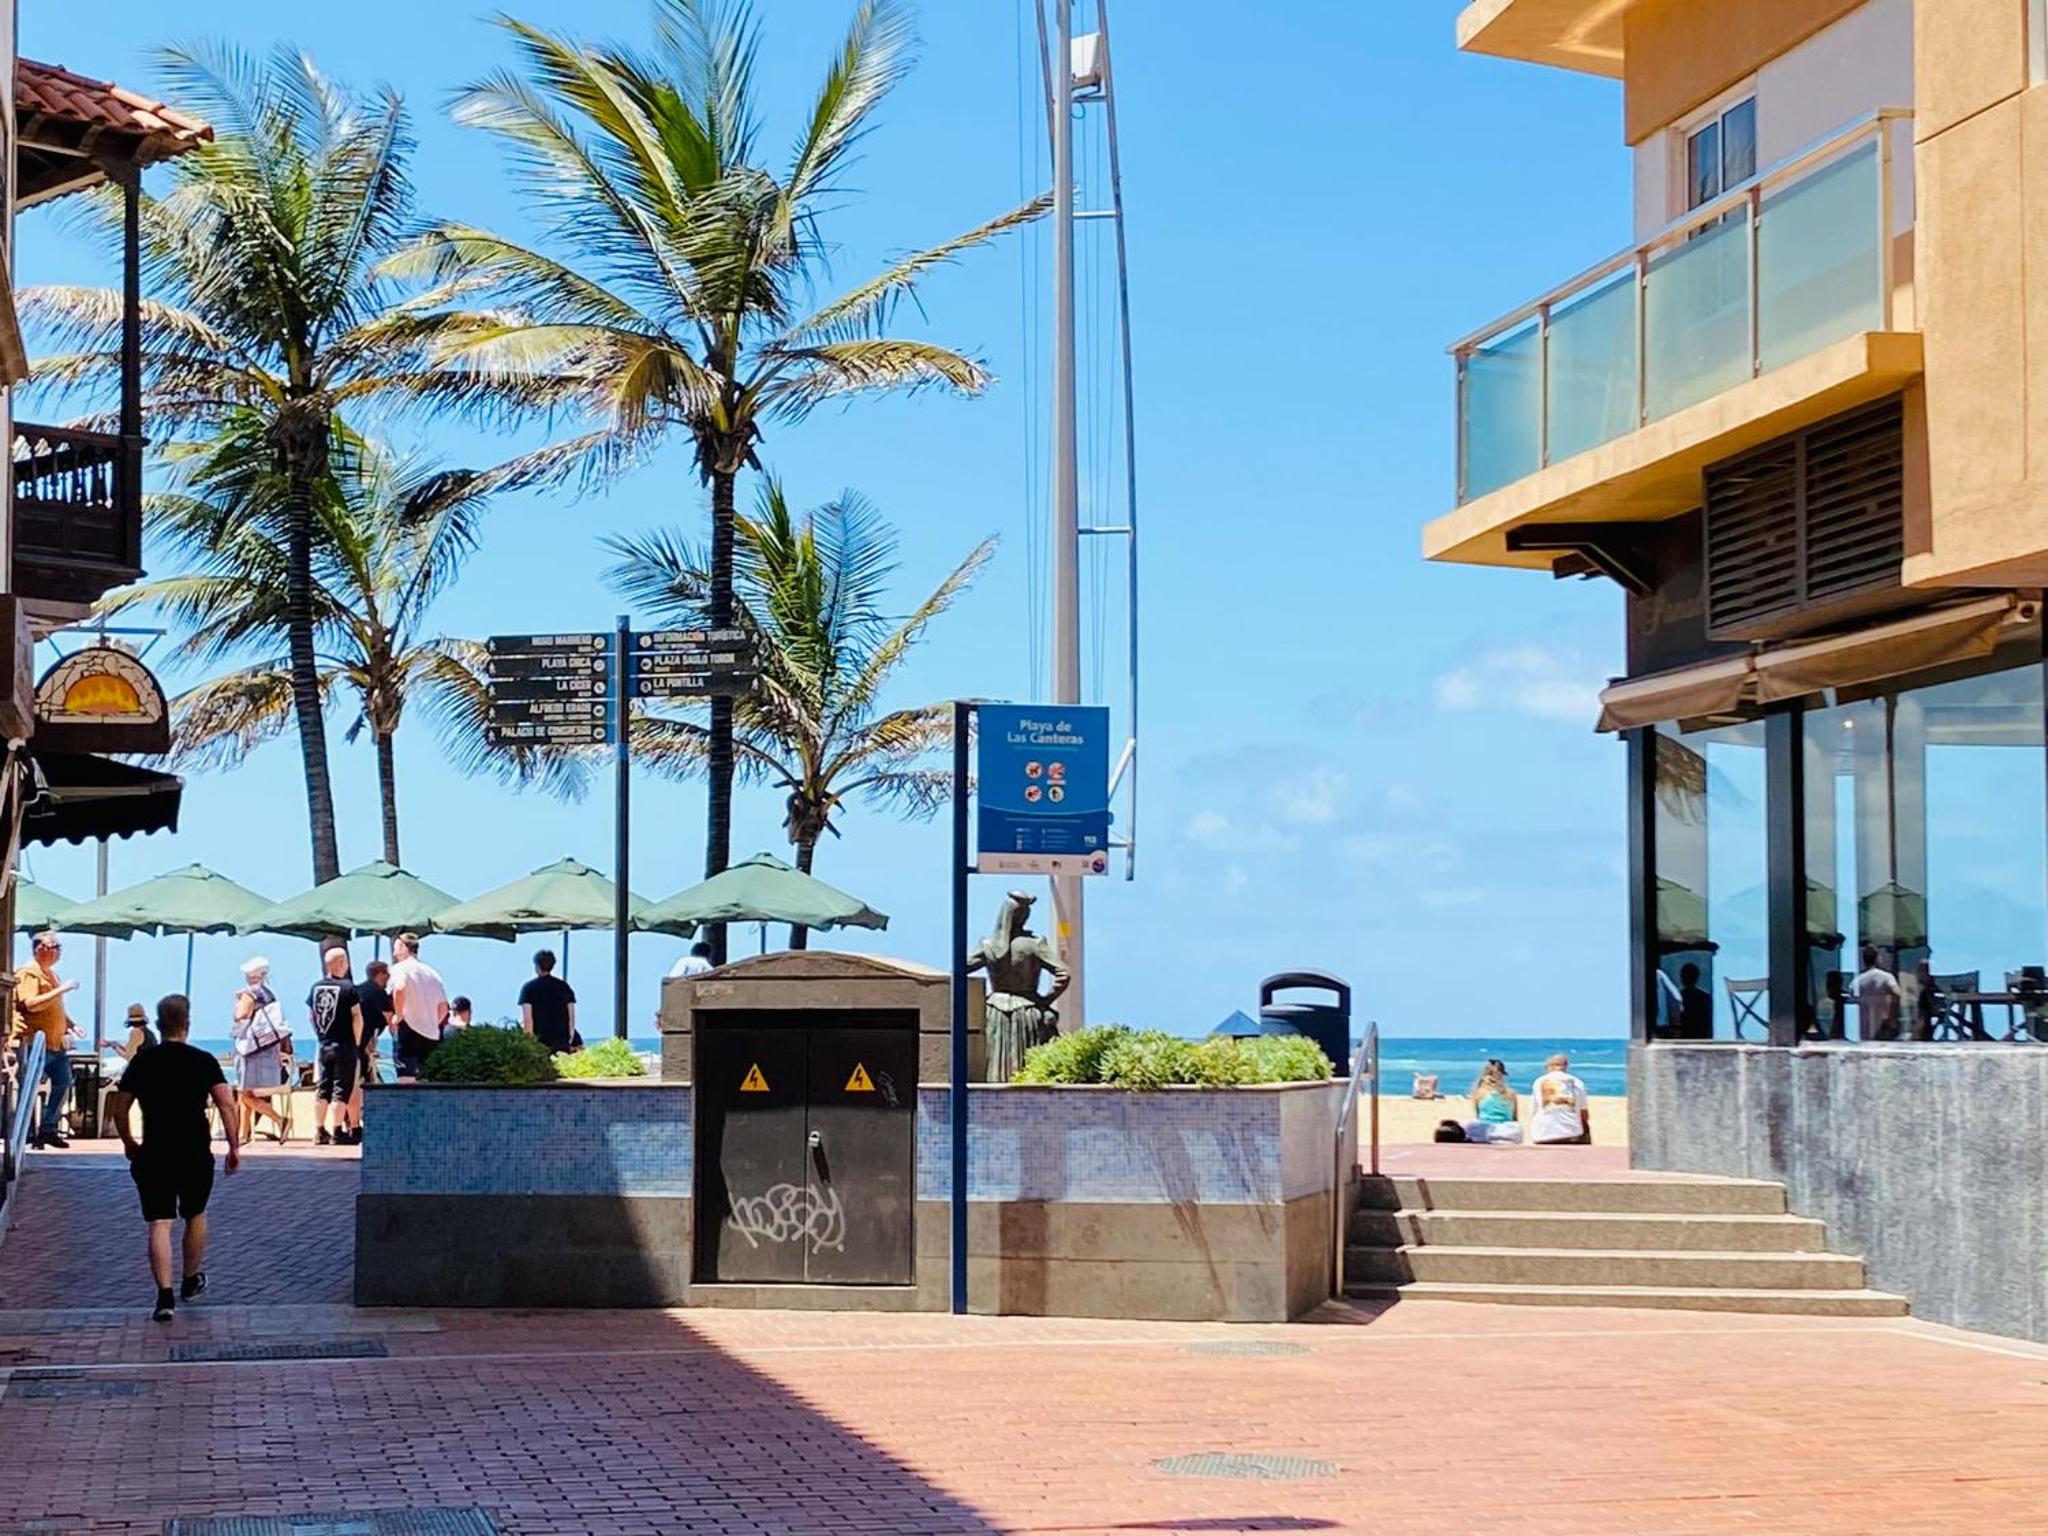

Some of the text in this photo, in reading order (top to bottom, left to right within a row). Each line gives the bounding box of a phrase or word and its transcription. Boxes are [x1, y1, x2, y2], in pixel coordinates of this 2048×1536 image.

[542, 658, 567, 668] PLAYA
[653, 654, 681, 665] PLAZA
[557, 681, 569, 691] LA
[653, 677, 705, 688] LA PUNTILLA
[530, 703, 563, 713] ALFREDO
[501, 726, 534, 737] PALACIO
[535, 726, 546, 737] DE
[1020, 719, 1072, 734] Playa de
[1007, 732, 1084, 745] Las Canteras
